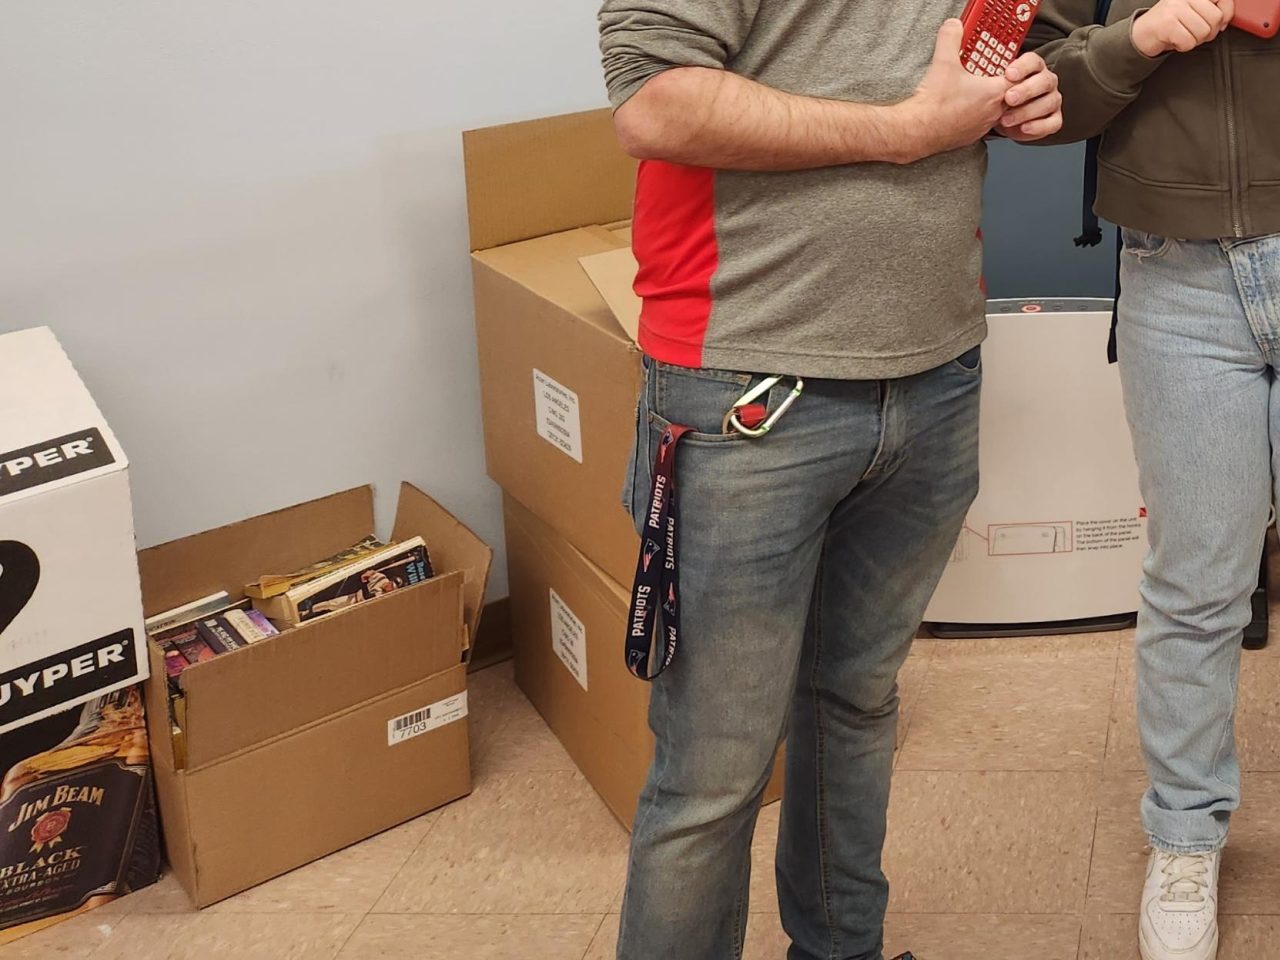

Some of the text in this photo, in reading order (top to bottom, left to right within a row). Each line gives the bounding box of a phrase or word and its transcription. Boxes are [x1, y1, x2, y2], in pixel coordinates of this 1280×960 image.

[0, 439, 94, 477] PER
[649, 474, 667, 529] PATRIOTS
[664, 516, 675, 571] PATRIOTS
[632, 584, 651, 638] PATRIOTS
[400, 722, 427, 739] 7703
[8, 784, 105, 833] JIM BEAM
[0, 847, 82, 880] BLACK
